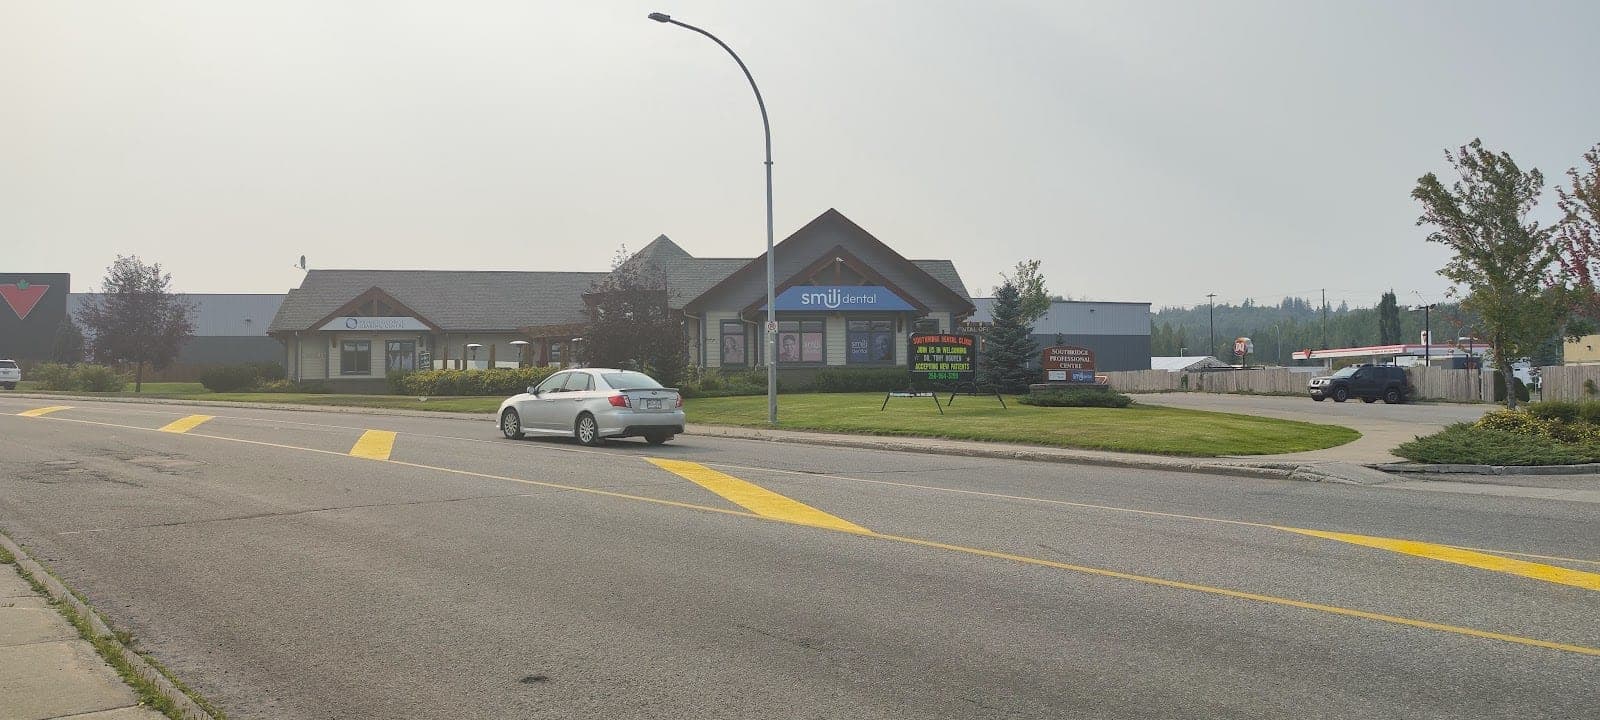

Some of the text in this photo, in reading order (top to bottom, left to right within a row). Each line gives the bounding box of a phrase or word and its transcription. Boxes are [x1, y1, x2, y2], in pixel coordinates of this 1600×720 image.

[842, 293, 877, 304] dental
[1049, 355, 1090, 363] PROFESSIONAL
[915, 362, 939, 370] ACCEPTING
[950, 362, 970, 370] PATIENTS
